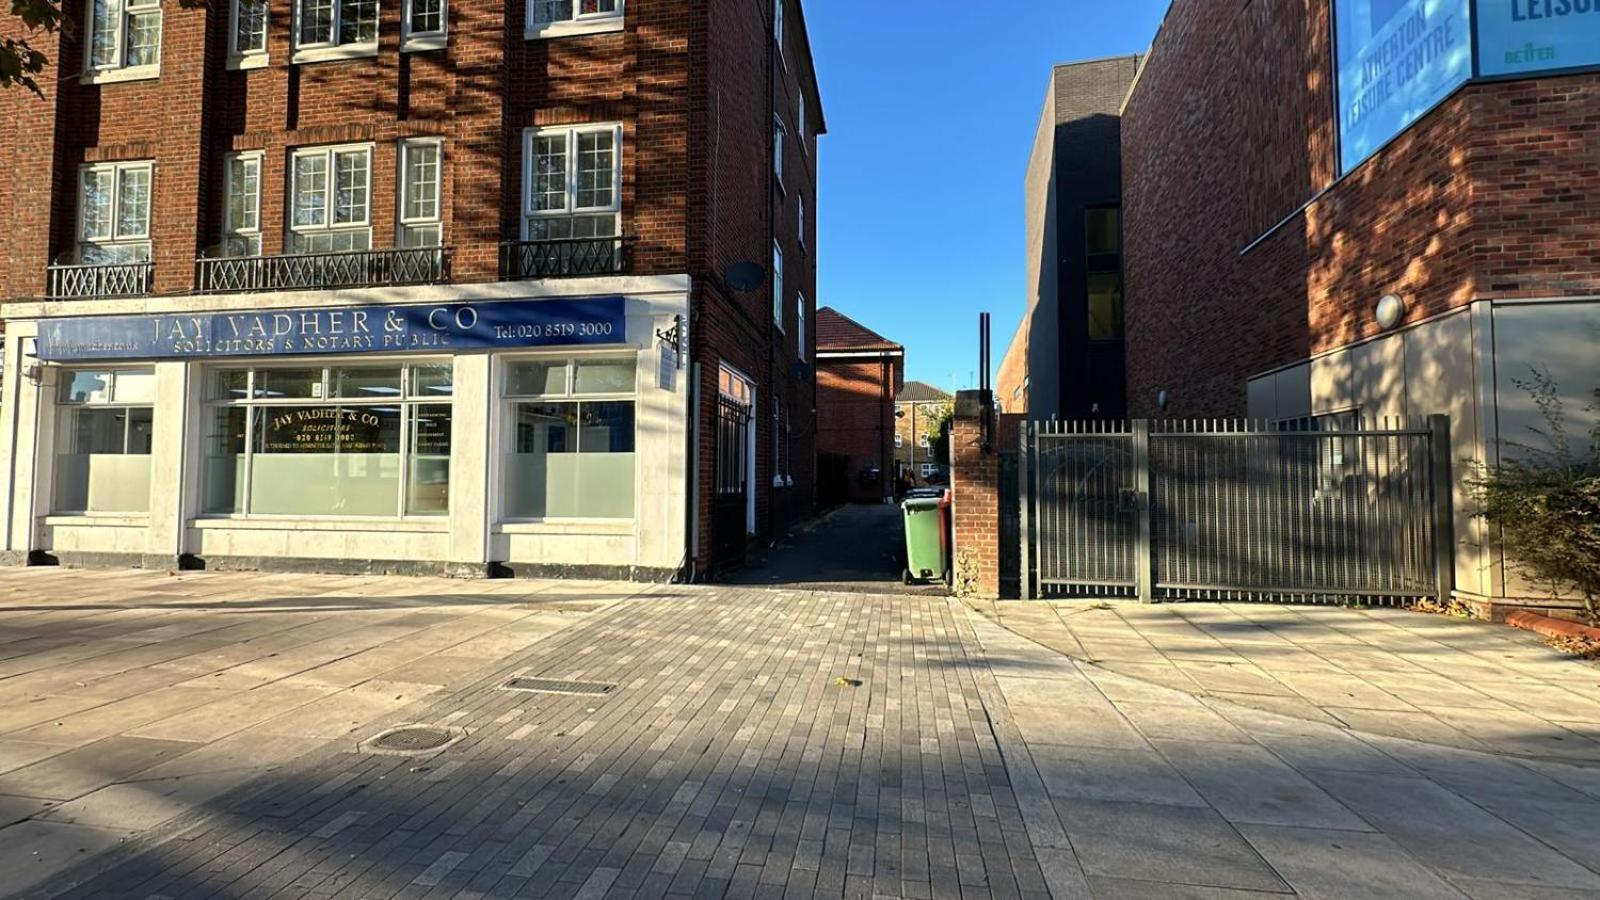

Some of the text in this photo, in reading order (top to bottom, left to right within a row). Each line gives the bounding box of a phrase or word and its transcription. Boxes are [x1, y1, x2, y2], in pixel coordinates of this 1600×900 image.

[1511, 0, 1600, 21] LEIS
[1361, 1, 1426, 88] ATHERTON
[1345, 14, 1455, 133] LEISURE CENTRE
[152, 306, 478, 344] JAY VADHER & CO
[494, 321, 613, 339] Tel: 020 8519 3000
[174, 332, 451, 353] SOLICITORS & NOTARY PUBLIC
[273, 413, 294, 431] JAY
[347, 411, 358, 421] &
